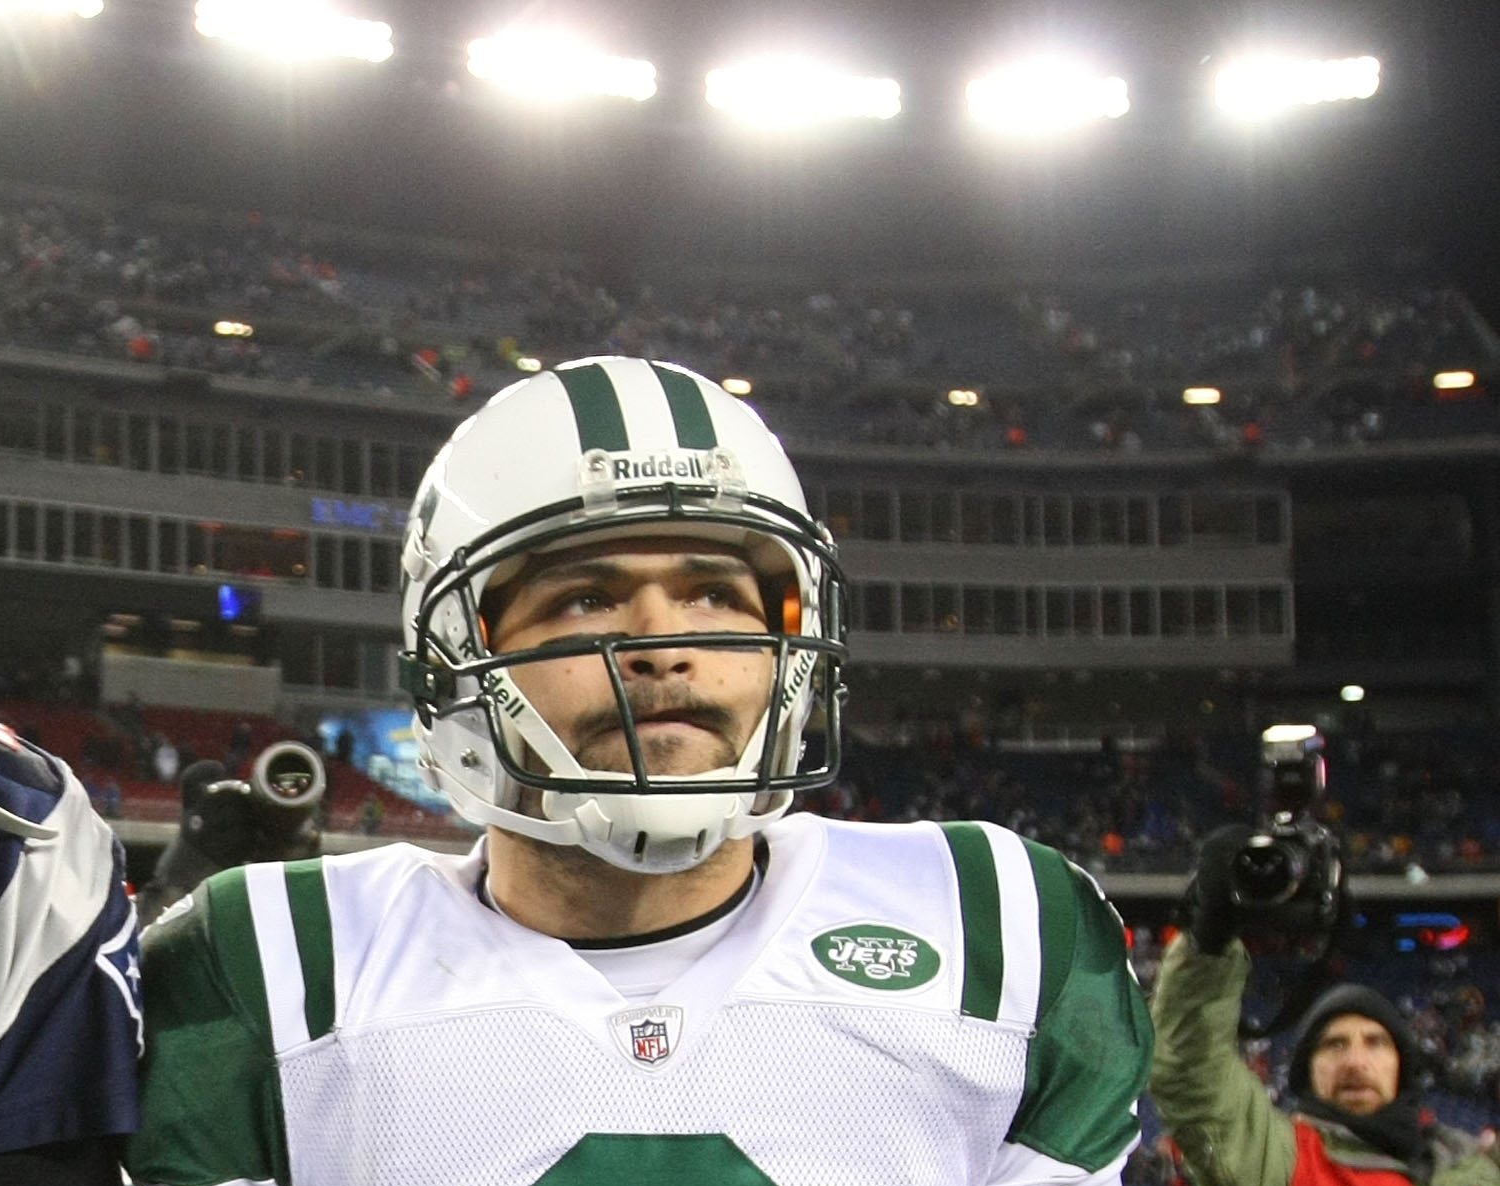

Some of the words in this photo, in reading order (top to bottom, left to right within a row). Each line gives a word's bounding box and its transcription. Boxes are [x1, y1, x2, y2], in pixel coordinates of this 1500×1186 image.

[613, 453, 703, 480] Riddell
[828, 942, 918, 966] JETS
[633, 1036, 668, 1058] NFL
